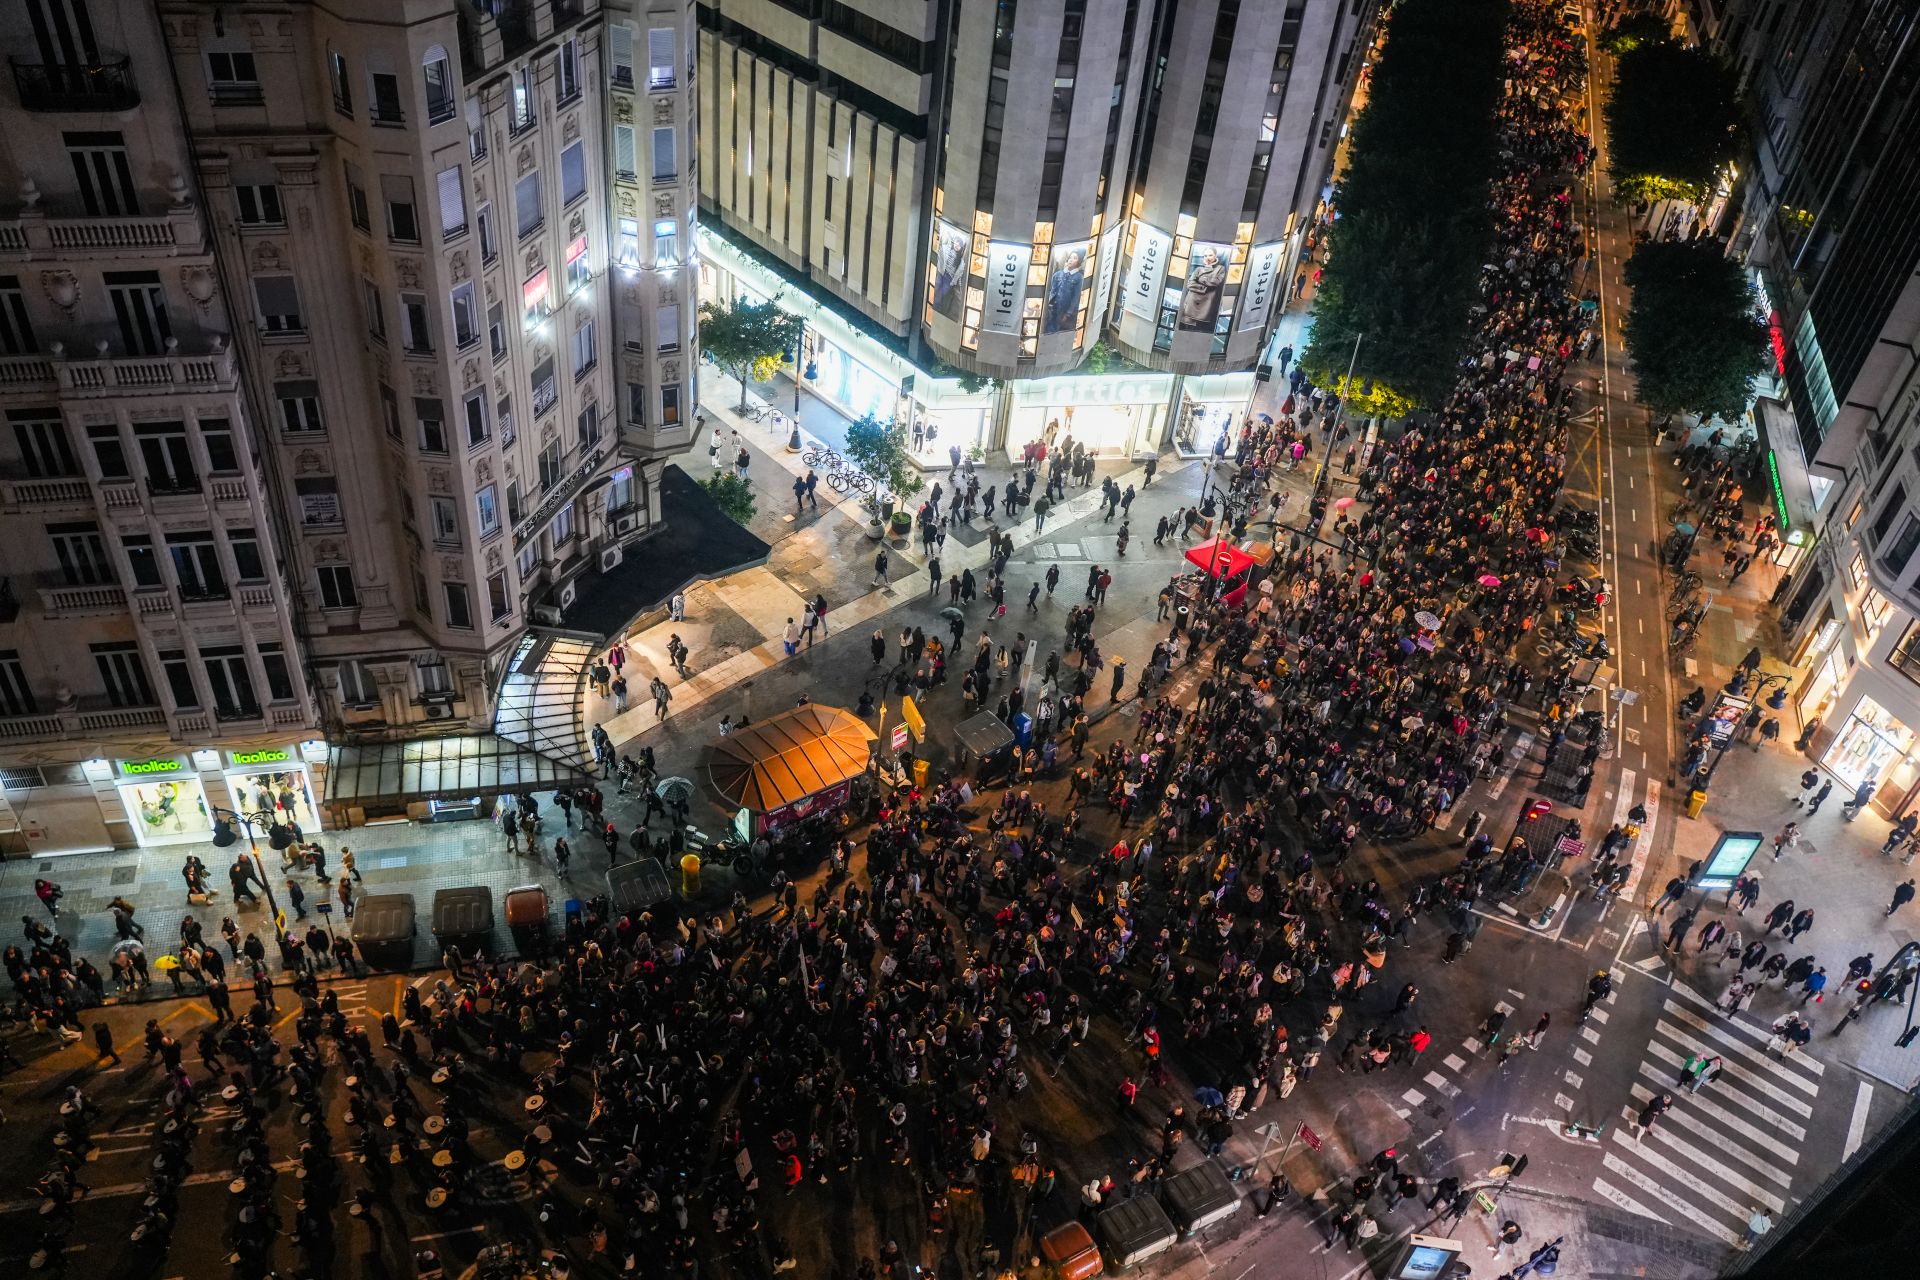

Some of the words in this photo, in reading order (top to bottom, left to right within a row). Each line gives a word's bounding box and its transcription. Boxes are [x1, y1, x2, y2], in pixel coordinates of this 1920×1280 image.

[996, 252, 1017, 315] lefties
[1136, 238, 1159, 299] lefties
[1250, 251, 1273, 313] lefties
